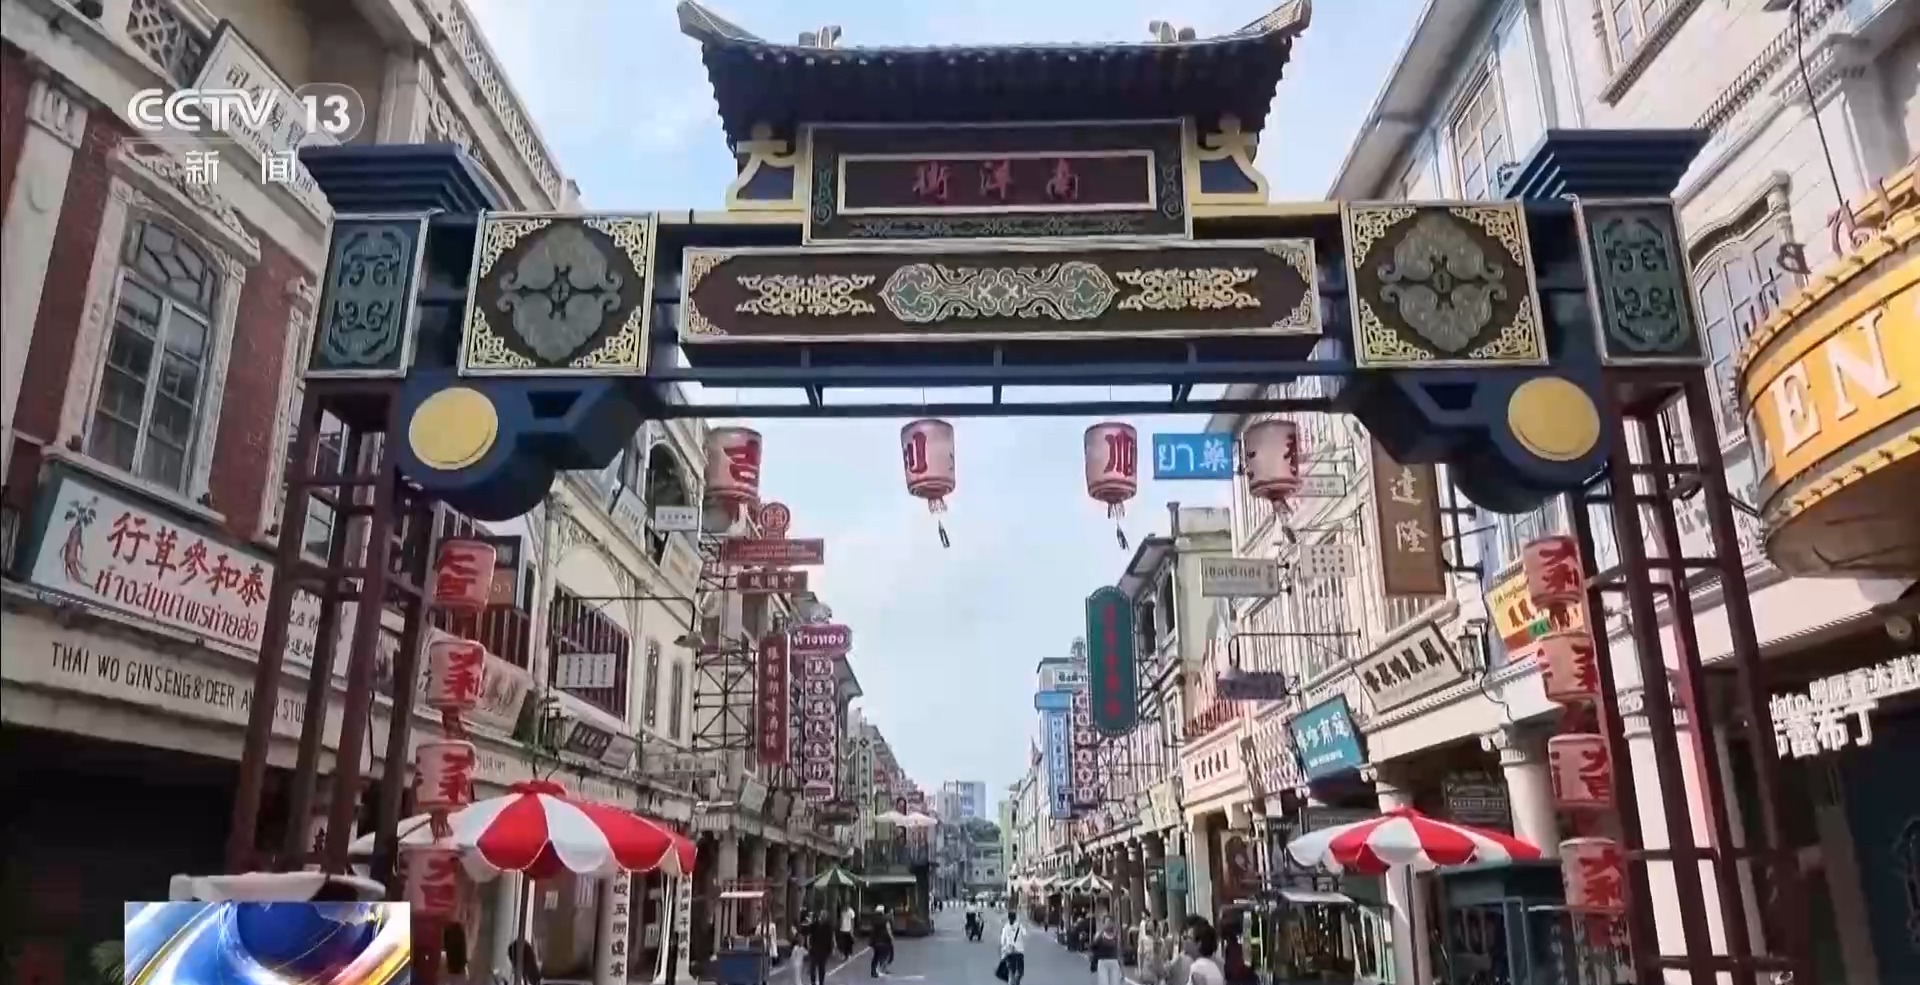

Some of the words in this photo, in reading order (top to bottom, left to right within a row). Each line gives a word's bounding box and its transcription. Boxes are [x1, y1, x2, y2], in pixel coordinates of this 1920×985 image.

[1157, 444, 1195, 472] ยา
[51, 642, 90, 674] THAI
[97, 654, 120, 683] WO
